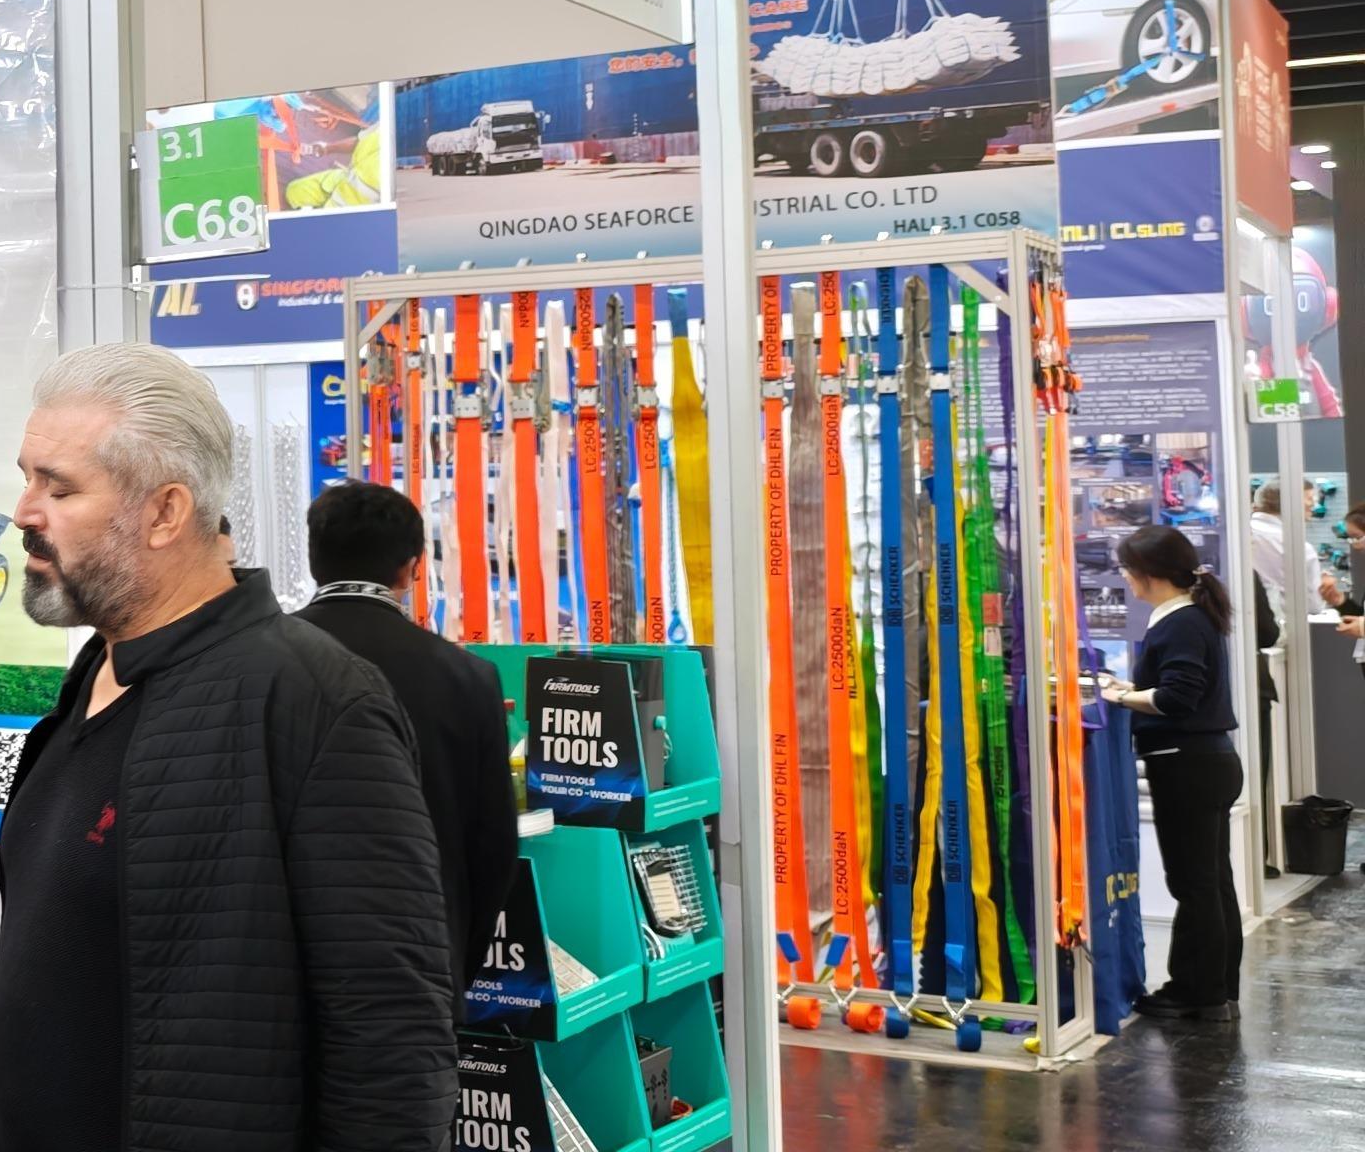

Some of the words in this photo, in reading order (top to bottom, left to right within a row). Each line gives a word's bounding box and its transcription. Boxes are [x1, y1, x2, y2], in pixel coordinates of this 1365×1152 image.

[162, 127, 204, 162] 3.1
[164, 195, 257, 246] C68
[479, 214, 578, 240] QINGDAO
[584, 204, 694, 231] SEAFORCE
[753, 189, 838, 217] STRIAL
[845, 187, 885, 210] CO.
[893, 185, 939, 207] LTD
[940, 215, 968, 230] 3.1
[974, 211, 1021, 228] C058
[261, 278, 345, 297] SINGFOR
[765, 281, 778, 298] OF
[765, 301, 778, 372] PROPERTY
[1259, 402, 1300, 418] C58
[769, 427, 782, 450] FIN
[769, 452, 782, 479] DHL
[769, 481, 782, 500] OF
[769, 503, 783, 576] PROPERTY
[830, 607, 844, 691] LC:2500daN
[541, 707, 602, 738] FIRM
[540, 735, 619, 769] TOOLS
[775, 733, 787, 756] FIN
[540, 773, 564, 783] FIRM
[564, 775, 596, 787] TOOLS
[775, 759, 787, 786] DHL
[541, 784, 568, 796] YOUR
[568, 787, 584, 797] CO
[775, 787, 788, 807] OF
[773, 809, 788, 884] PROPERTY
[834, 830, 849, 916] LC:2500daN
[475, 992, 491, 1002] CO
